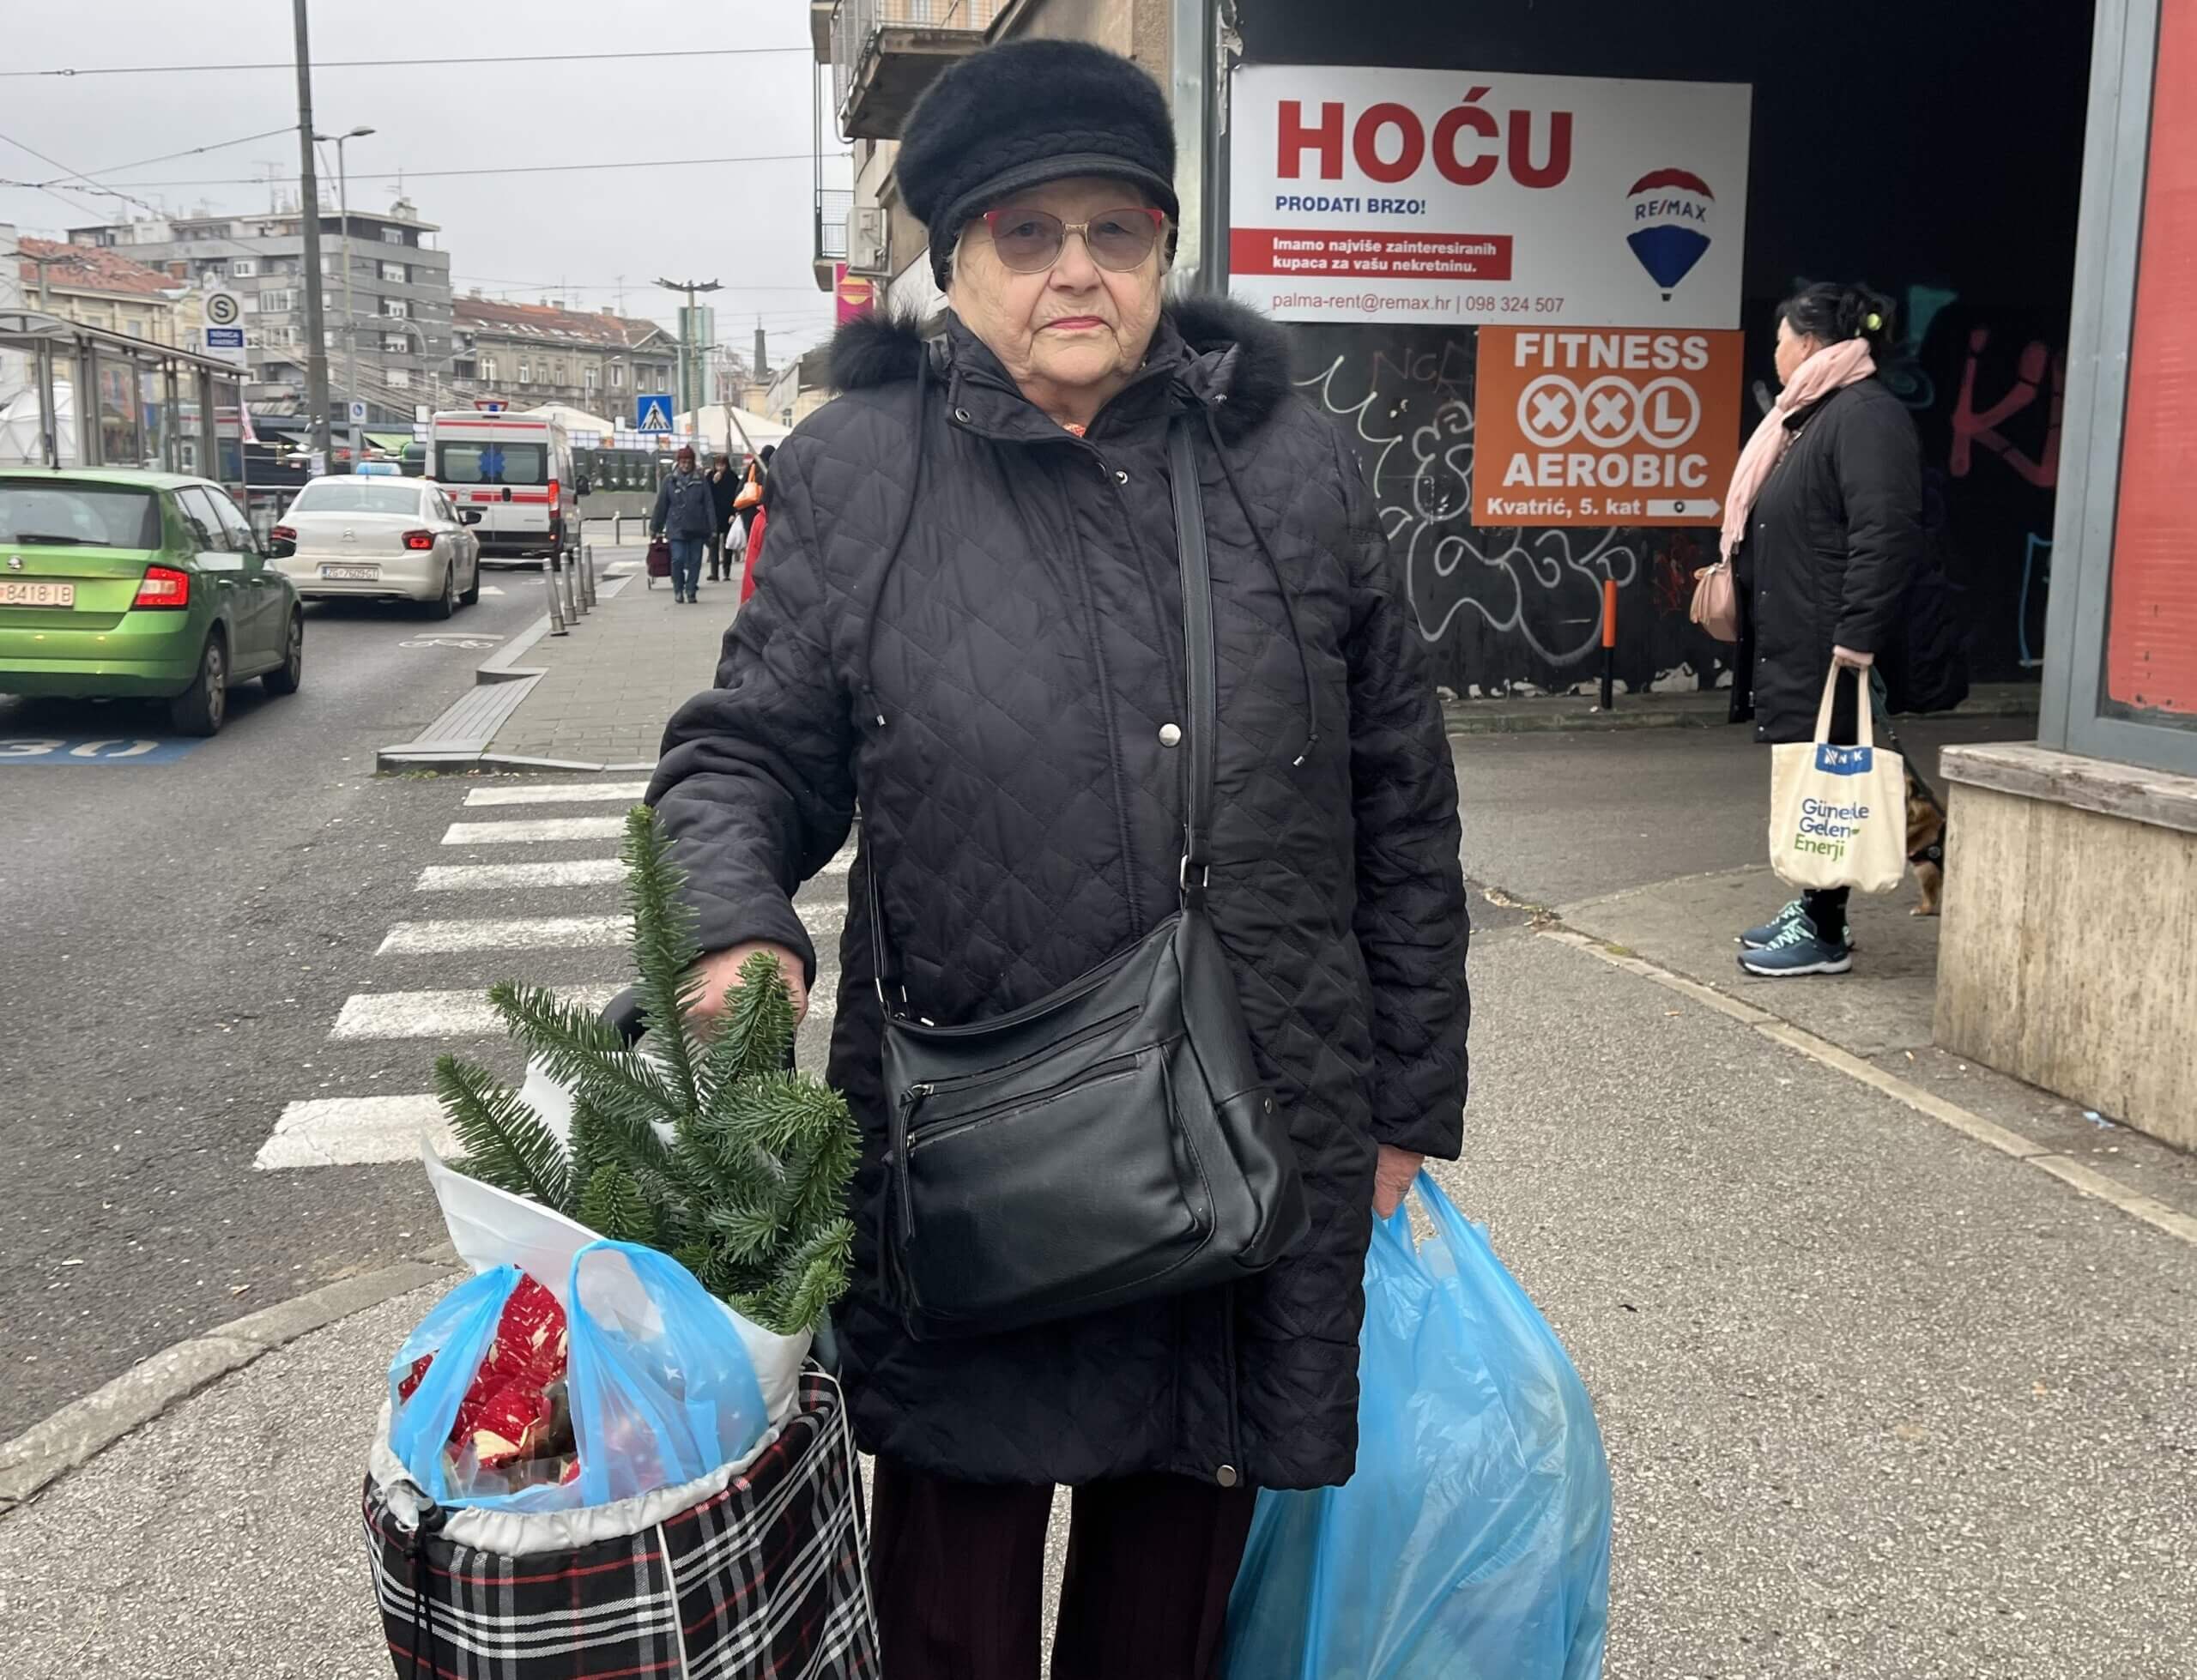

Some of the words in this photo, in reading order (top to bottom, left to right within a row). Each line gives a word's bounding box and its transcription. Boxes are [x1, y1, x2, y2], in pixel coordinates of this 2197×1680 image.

[1277, 86, 1573, 189] HOĆU
[1275, 196, 1360, 214] PRODATI
[1367, 198, 1426, 215] BRZO!
[1635, 199, 1707, 223] RE/MAX
[1273, 237, 1324, 251] Imamo
[1328, 239, 1382, 257] najviše
[1385, 241, 1497, 256] zainteresiranih
[1273, 256, 1328, 271] kupaca
[1331, 258, 1349, 270] za
[1353, 257, 1389, 271] vašu
[1393, 258, 1477, 273] nekretninu.
[215, 300, 228, 318] S
[1273, 293, 1451, 313] palma-rent@remax.hr
[1466, 296, 1496, 311] 098
[1500, 297, 1530, 312] 324
[1534, 298, 1565, 313] 507
[1515, 333, 1709, 371] FITNESS
[1503, 453, 1709, 488] AEROBIC
[1486, 498, 1572, 518] Kvatrić,
[1579, 499, 1599, 516] 5.
[1606, 499, 1641, 516] kat
[1800, 816, 1851, 838] Gelen
[1794, 833, 1845, 861] Enerji
